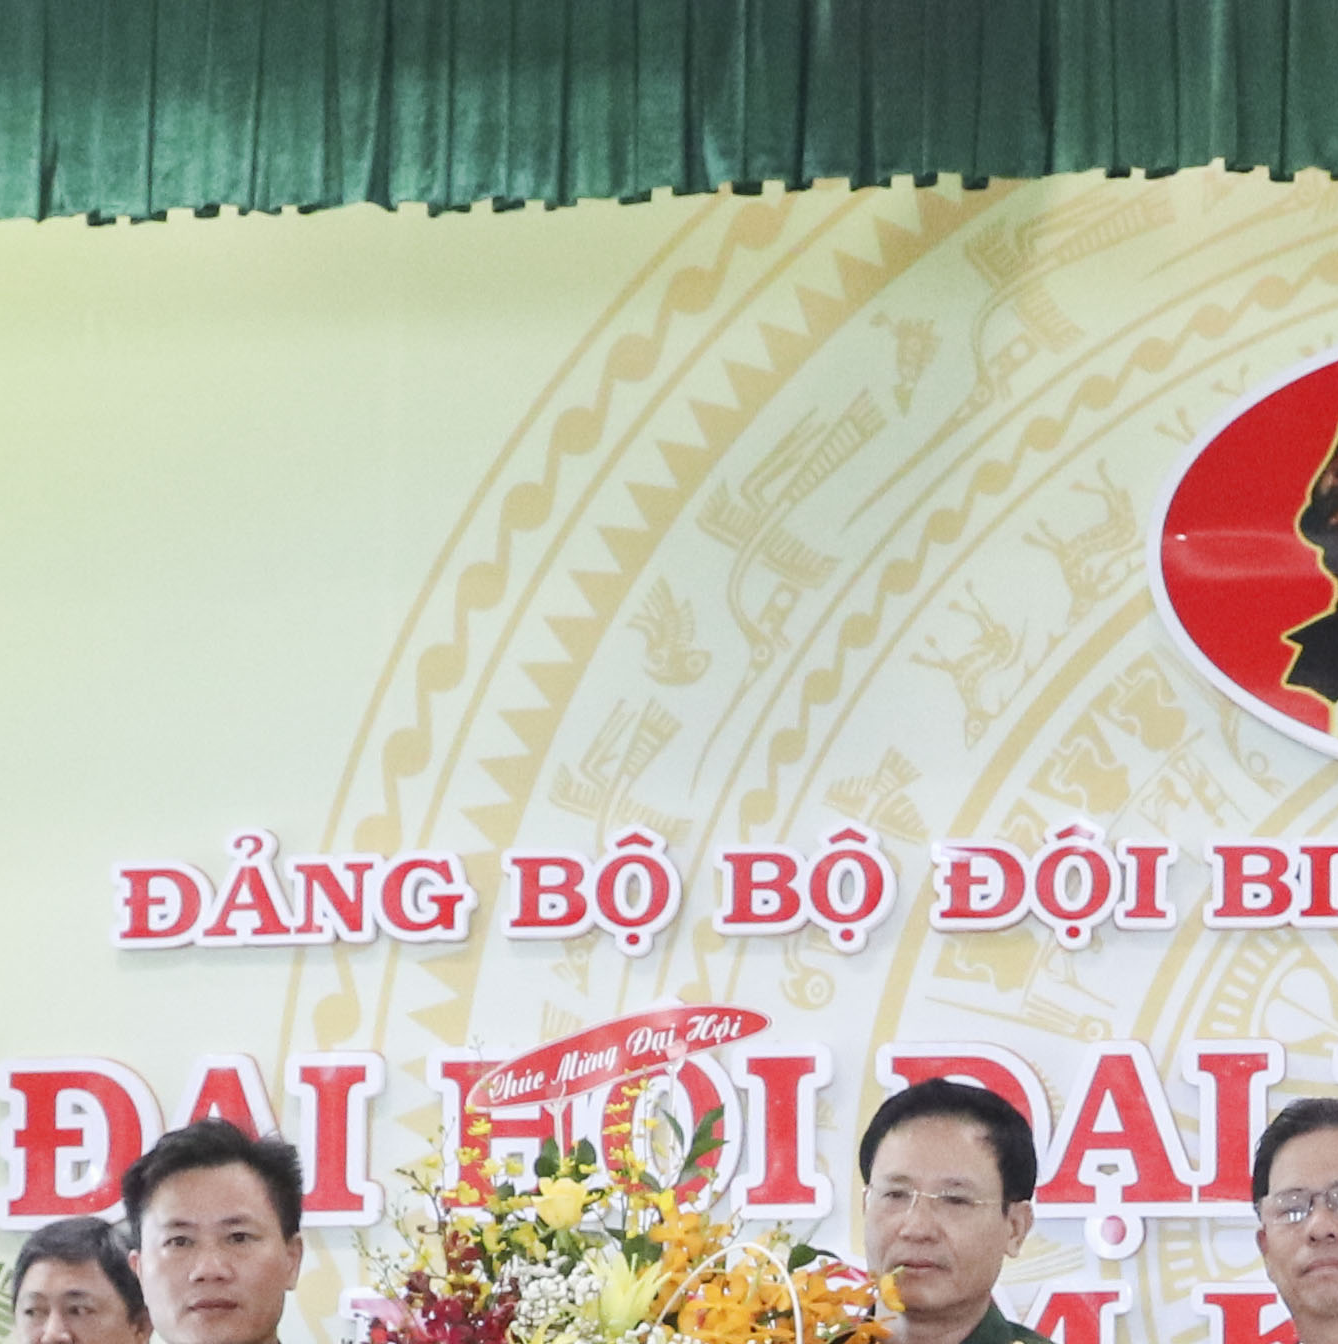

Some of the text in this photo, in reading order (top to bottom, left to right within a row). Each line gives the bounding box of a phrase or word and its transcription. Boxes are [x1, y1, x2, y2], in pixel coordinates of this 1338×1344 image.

[121, 834, 465, 939] ĐẢNG
[512, 832, 670, 948] BỘ
[724, 828, 884, 945] BỘ
[941, 824, 1167, 942] ĐỘI
[550, 1046, 620, 1085] Mừng
[626, 1024, 676, 1057] Đại
[686, 1014, 742, 1043] Hội
